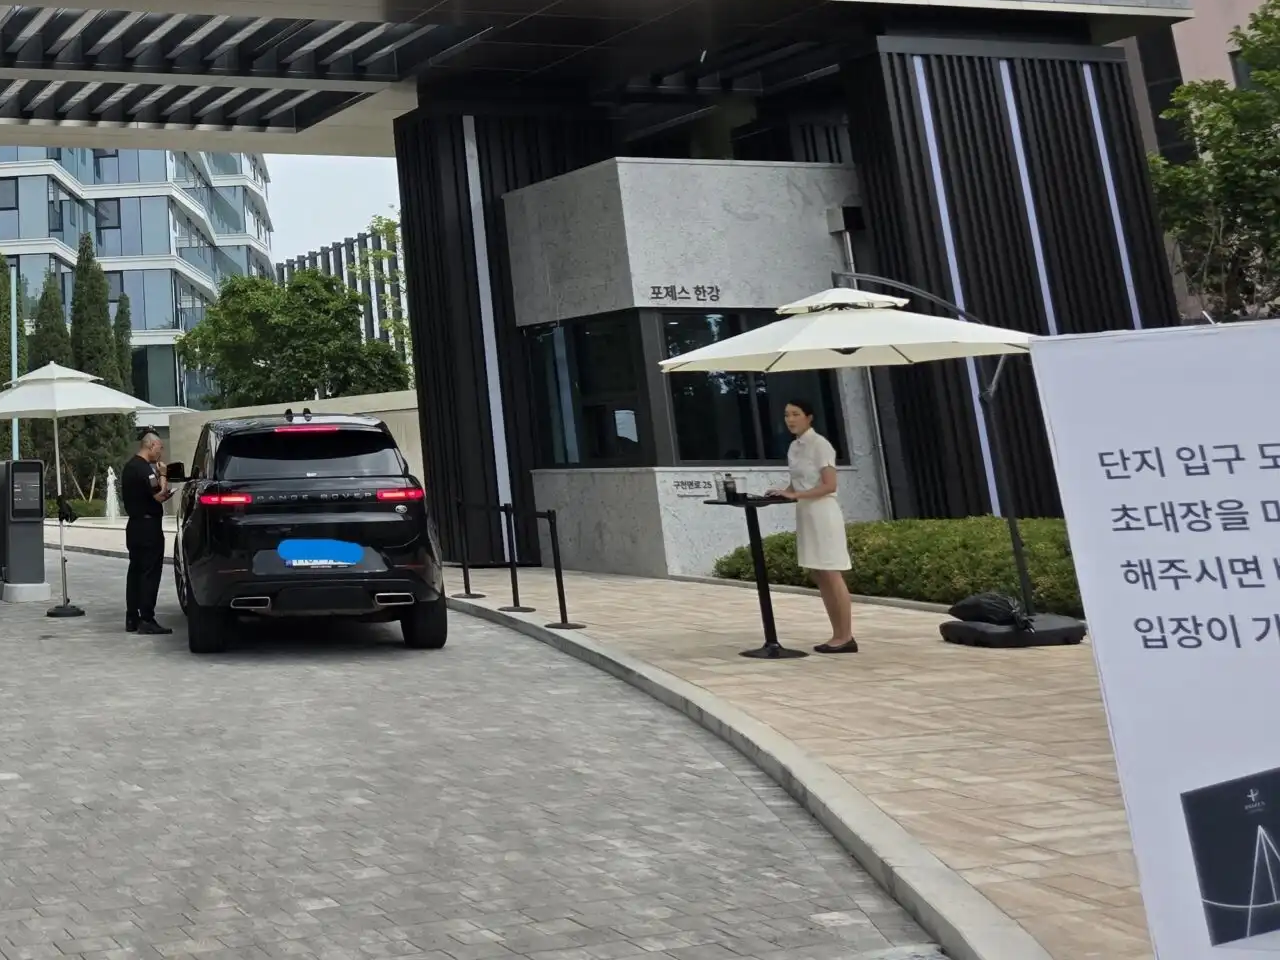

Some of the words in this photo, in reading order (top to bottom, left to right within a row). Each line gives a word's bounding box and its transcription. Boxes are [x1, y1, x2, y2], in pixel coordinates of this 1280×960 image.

[650, 284, 691, 301] 포제스
[693, 284, 720, 302] 한강
[1098, 446, 1166, 480] 단지
[1175, 444, 1246, 477] 입구
[320, 492, 372, 500] ROVER
[1110, 498, 1251, 533] 초대장을
[1120, 555, 1266, 591] 해주시면
[1133, 614, 1242, 650] 입장이
